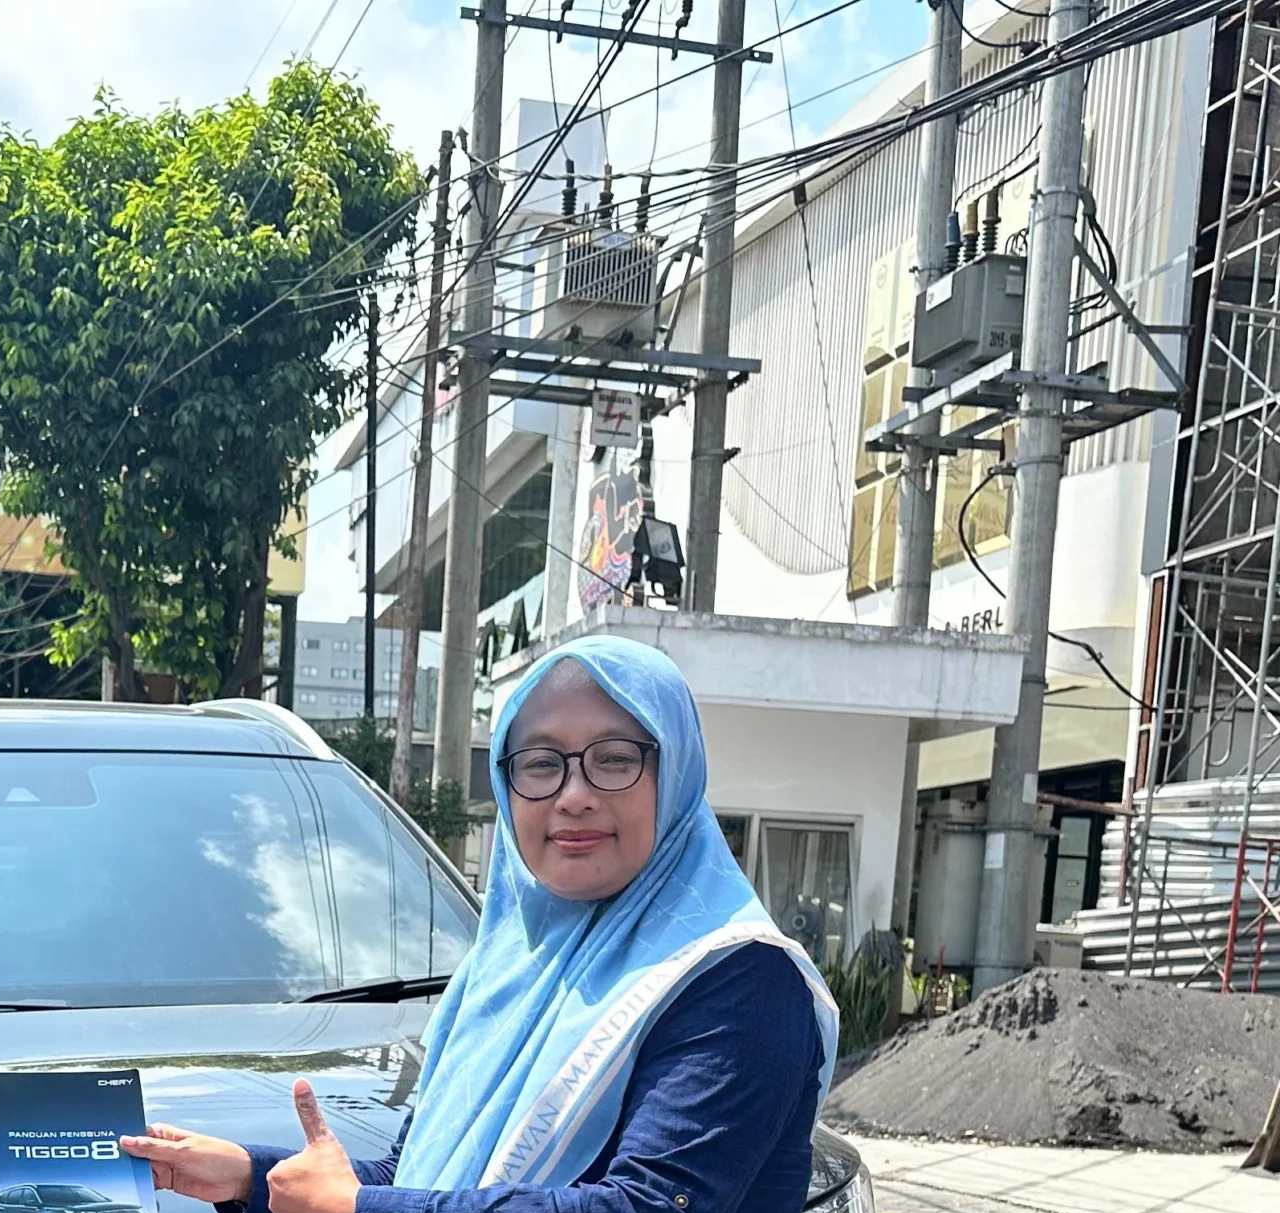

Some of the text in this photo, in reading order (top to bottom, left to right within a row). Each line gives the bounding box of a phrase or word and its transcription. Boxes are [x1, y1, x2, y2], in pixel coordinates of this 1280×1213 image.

[97, 1078, 134, 1086] CHERY
[8, 1129, 116, 1138] PANDUAN PENGGUNA
